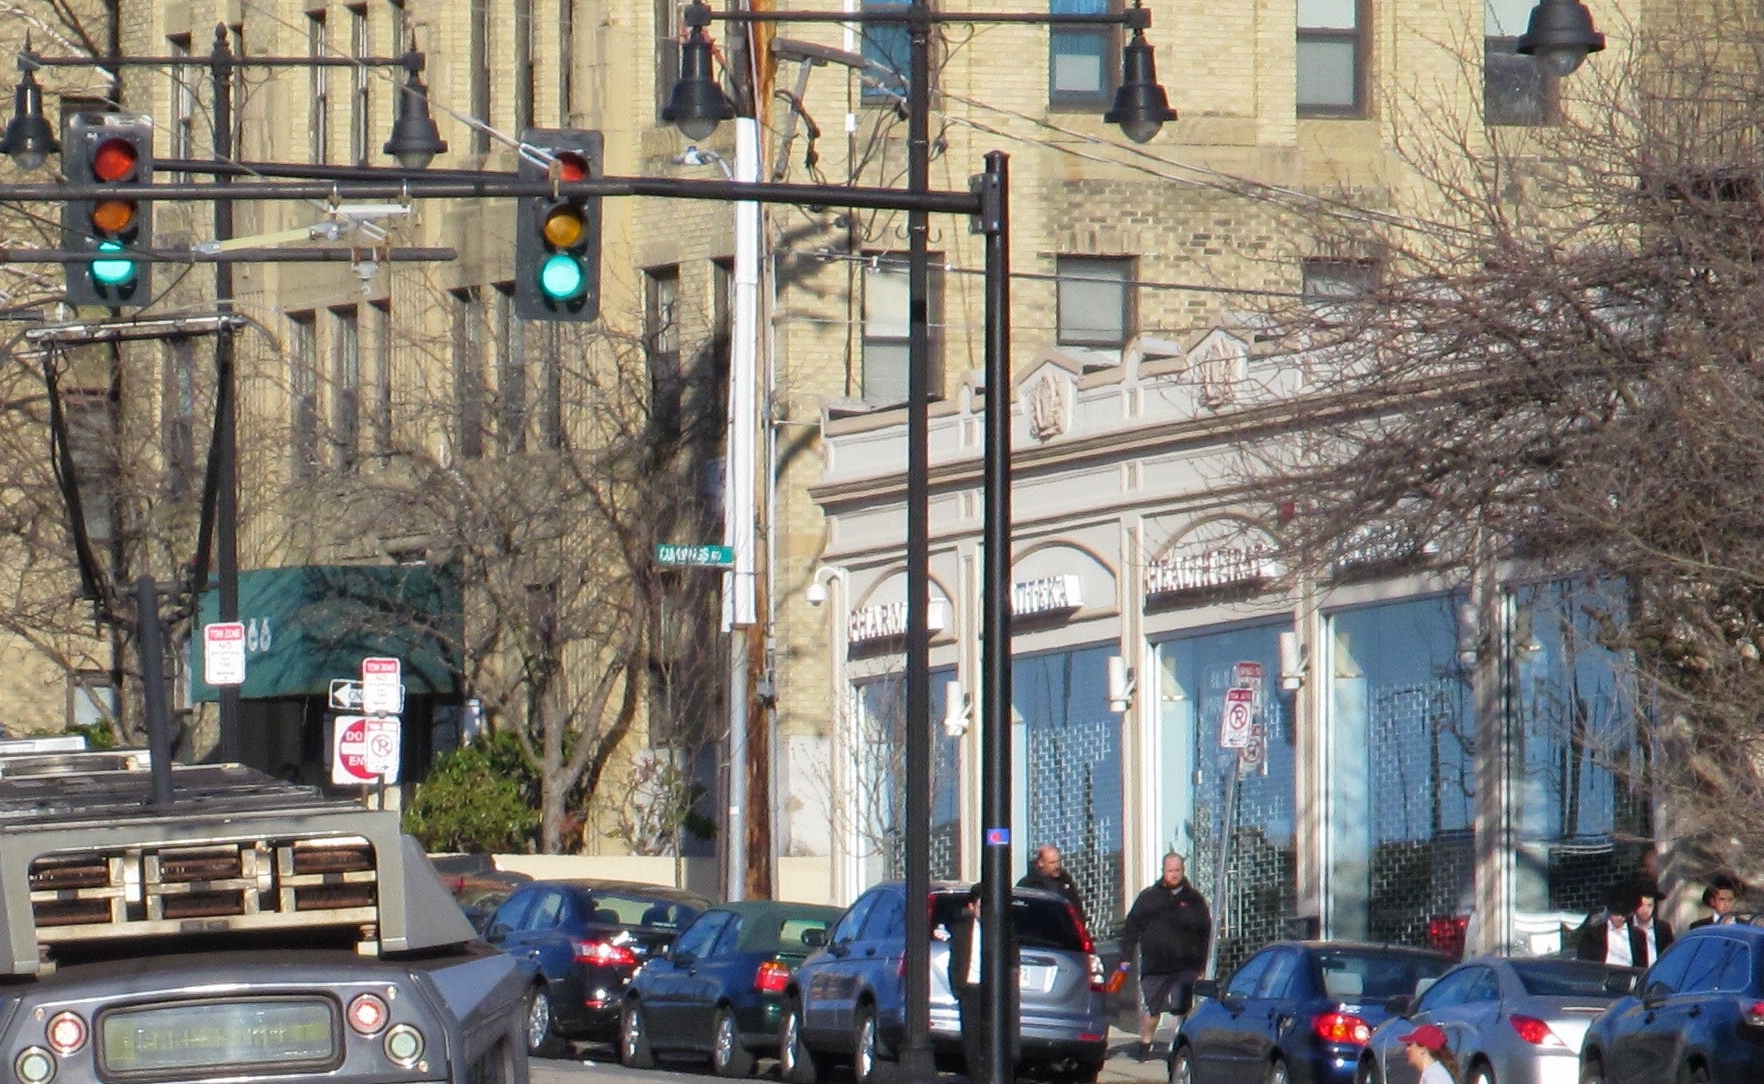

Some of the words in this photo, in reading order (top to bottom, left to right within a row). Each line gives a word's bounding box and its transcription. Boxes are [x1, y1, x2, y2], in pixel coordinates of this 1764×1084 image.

[247, 616, 272, 652] 66
[848, 602, 908, 642] PHARM
[348, 689, 364, 701] ON
[346, 730, 363, 742] DO
